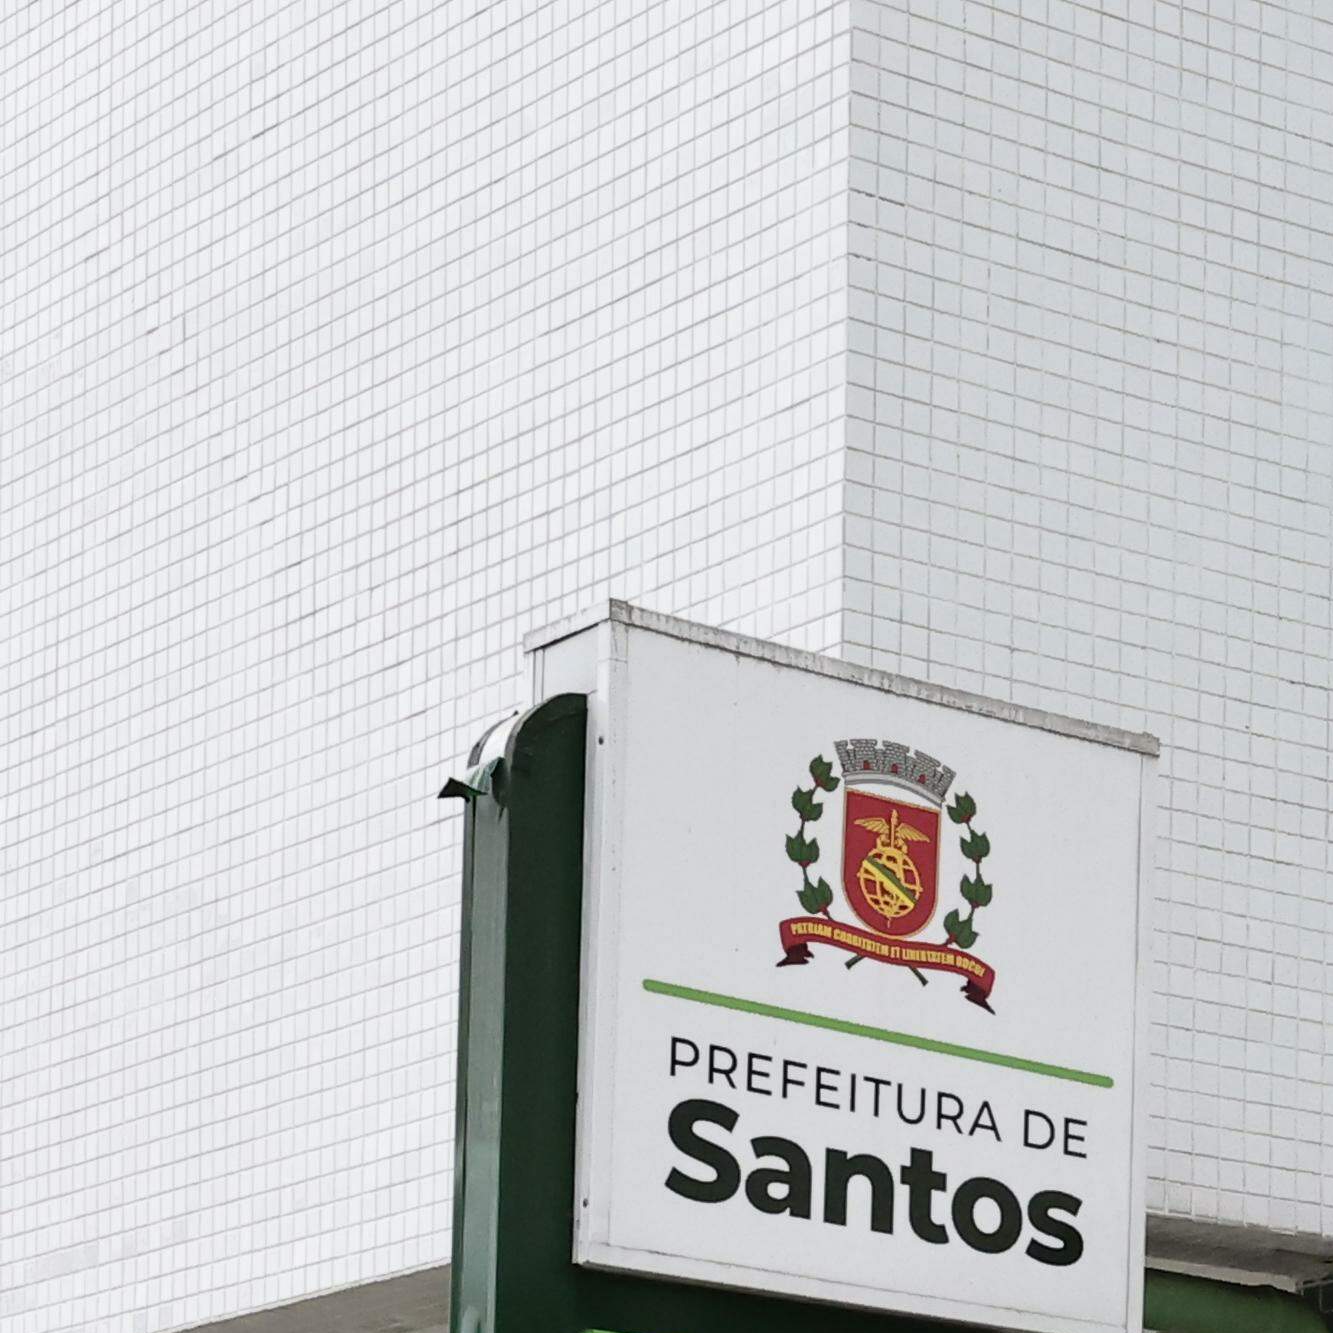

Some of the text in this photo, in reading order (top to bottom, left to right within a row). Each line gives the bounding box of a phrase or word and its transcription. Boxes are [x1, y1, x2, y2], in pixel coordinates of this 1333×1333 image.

[670, 1036, 1089, 1158] PREFEITURA DE
[665, 1097, 1085, 1267] Santos
